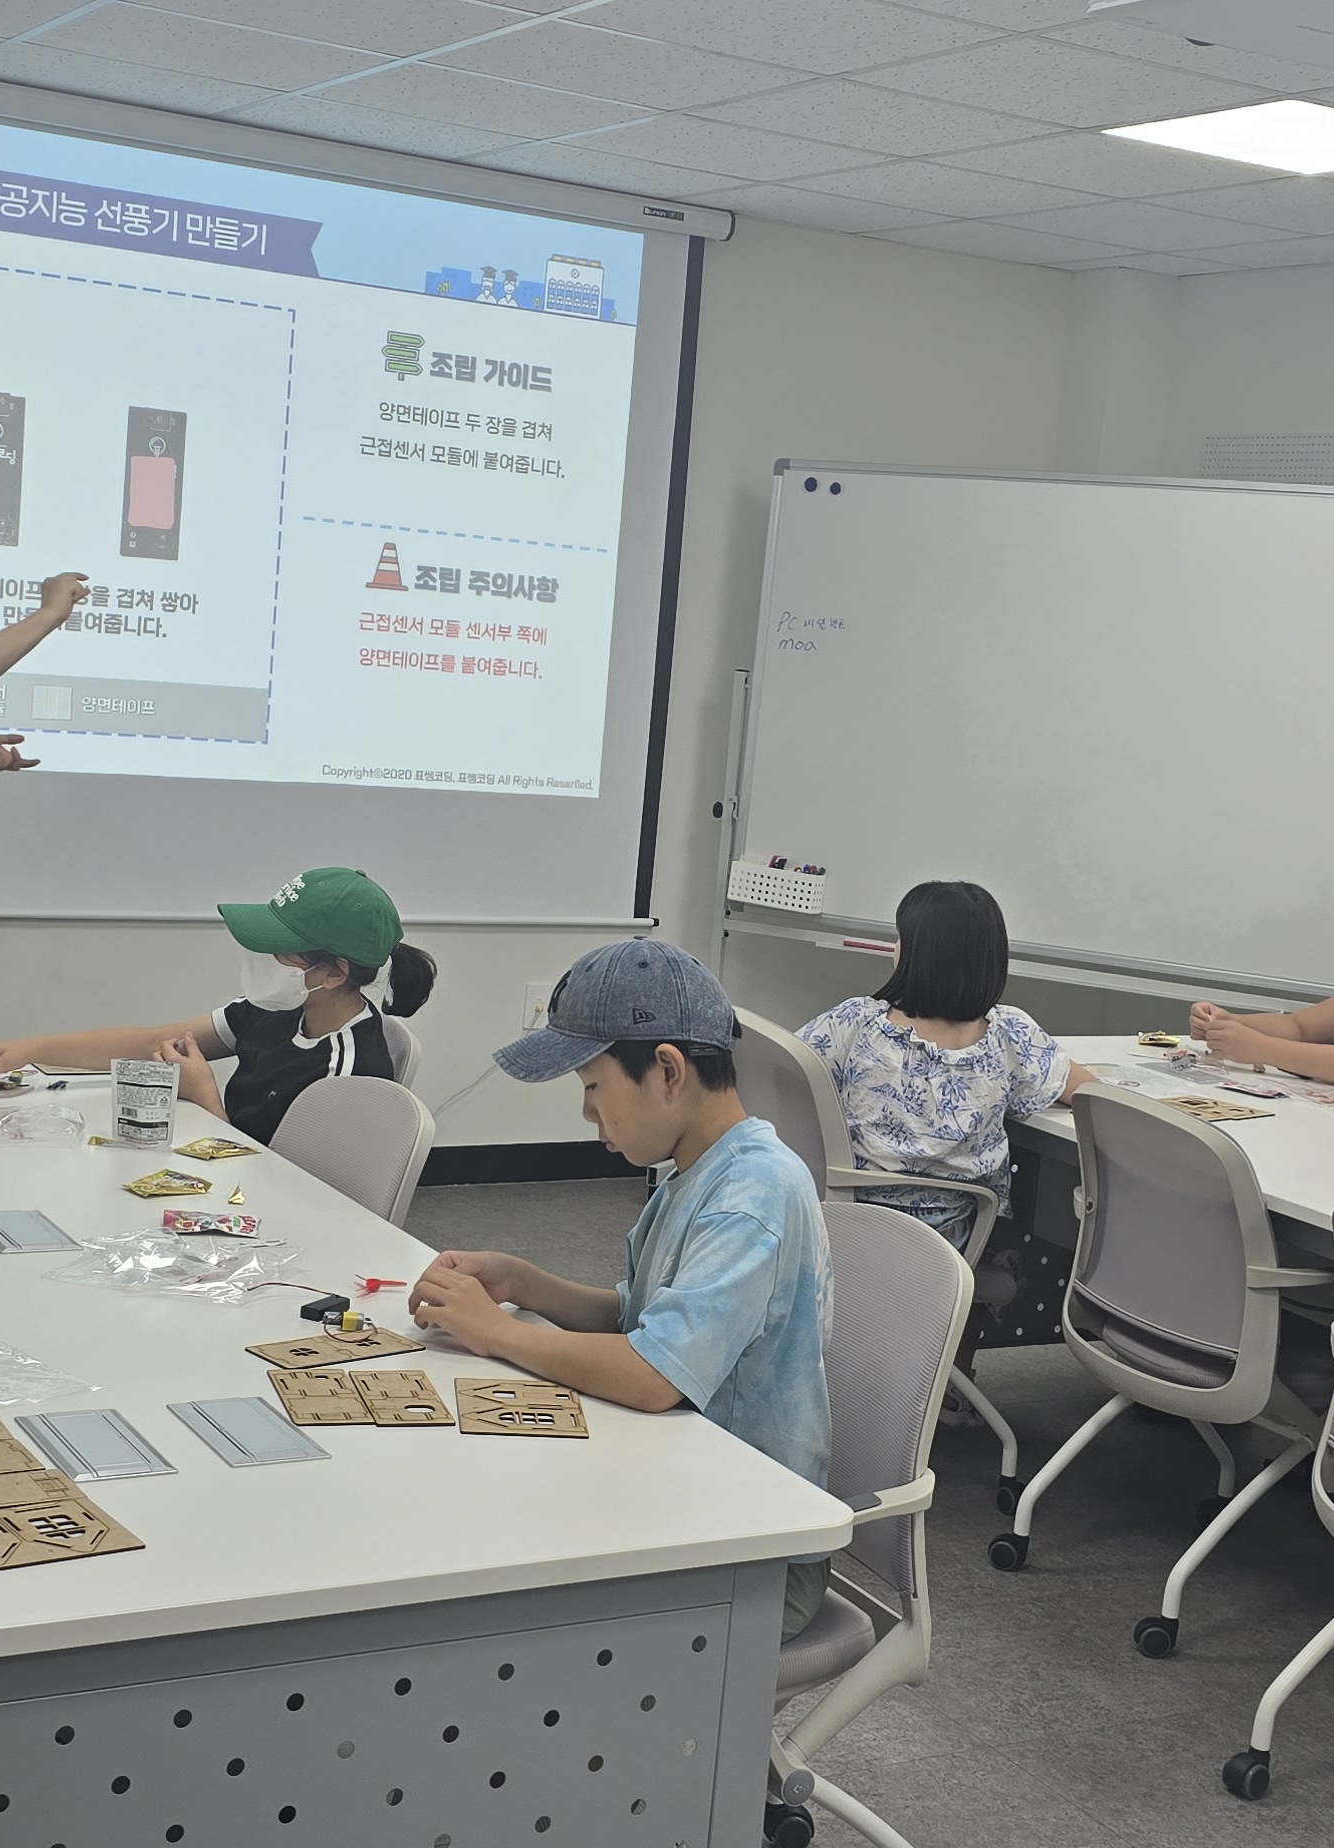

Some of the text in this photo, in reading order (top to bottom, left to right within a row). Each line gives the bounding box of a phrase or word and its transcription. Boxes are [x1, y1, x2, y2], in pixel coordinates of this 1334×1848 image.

[94, 200, 179, 242] 선풍기
[185, 213, 268, 255] 만들기
[430, 351, 552, 393] 조립 가이드
[379, 401, 553, 442] 양면테이프 두 장을 겹쳐
[359, 435, 565, 479] 근접센서 모듈에 붙여줍니다.
[116, 588, 155, 611] 겹쳐
[160, 591, 199, 614] 쌓아
[414, 564, 560, 603] 조립 주의사항
[359, 611, 548, 646] 근접센서 모듈 센서부 쪽에
[778, 638, 817, 651] moa
[359, 648, 543, 679] 양면테이프를 붙여줍니다.
[81, 696, 156, 715] 양면테이프
[497, 774, 511, 785] All
